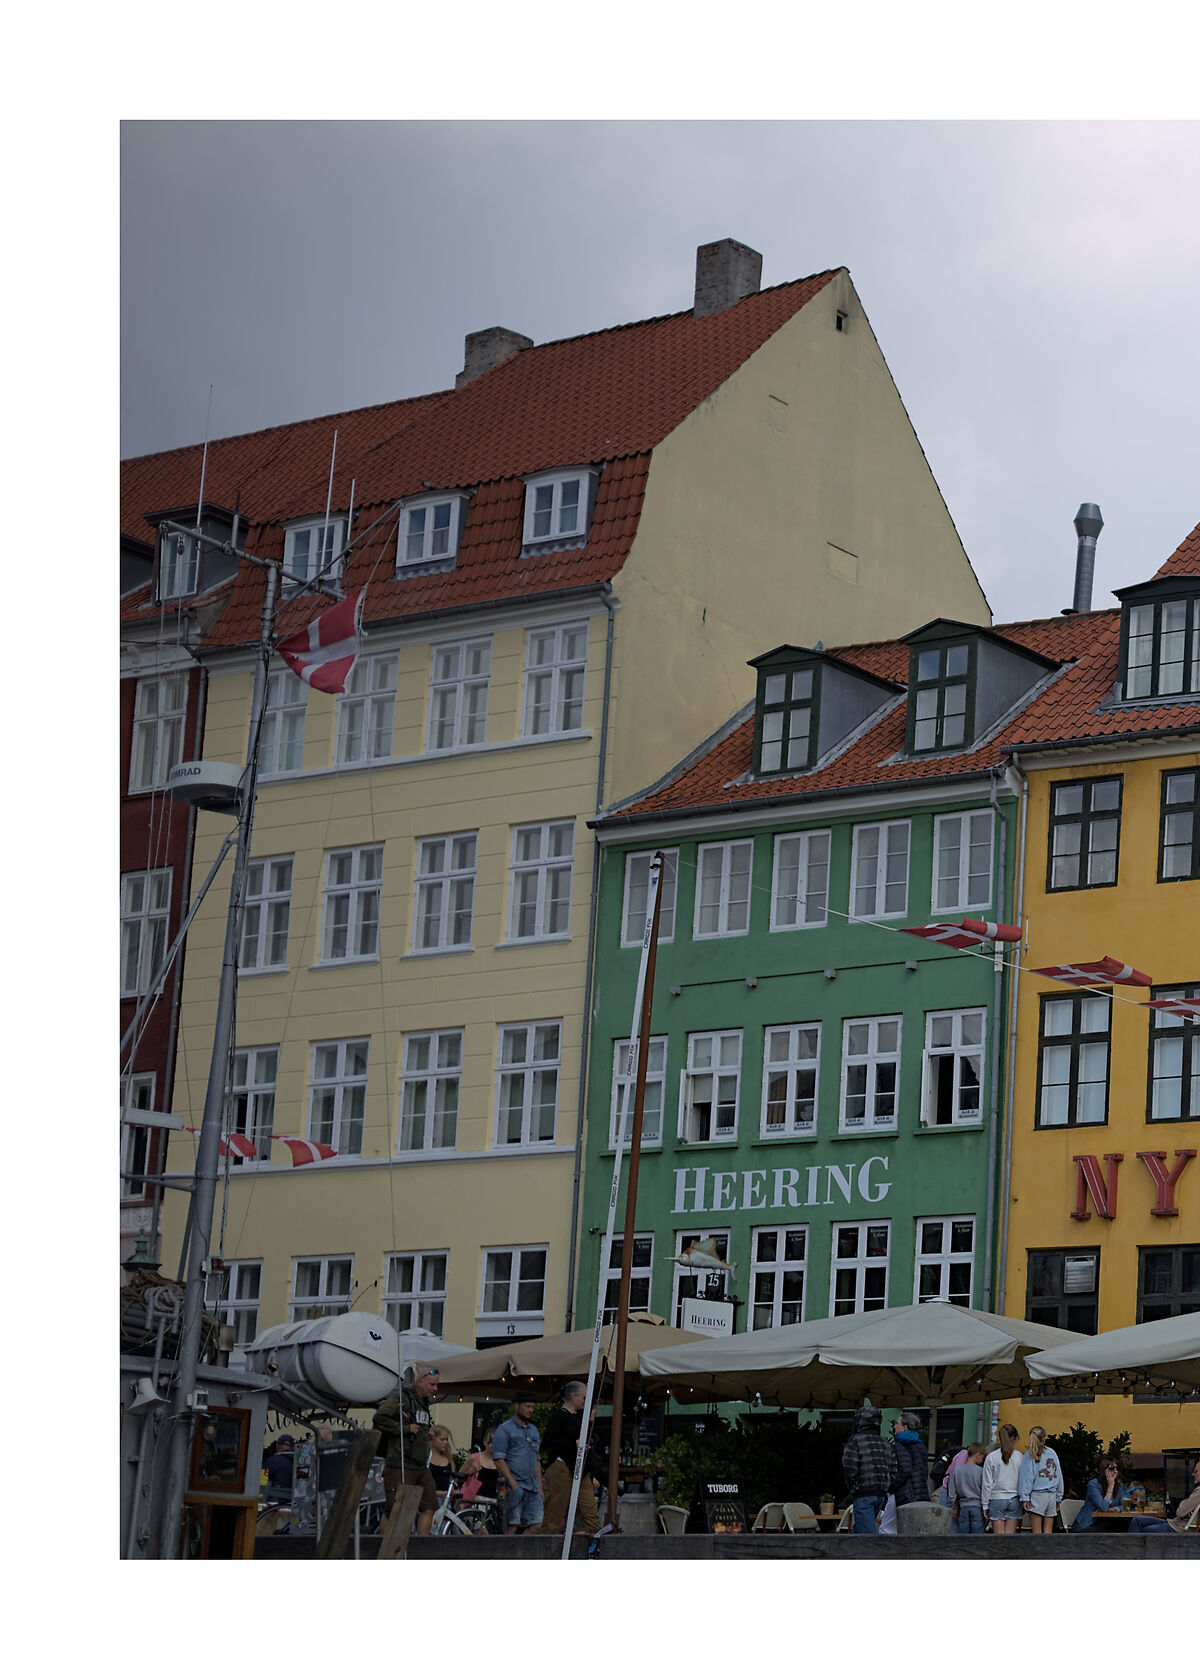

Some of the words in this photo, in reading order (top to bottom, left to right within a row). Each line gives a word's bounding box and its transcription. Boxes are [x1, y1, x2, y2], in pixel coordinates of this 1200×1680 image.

[171, 767, 201, 779] MRAD
[670, 1156, 892, 1213] HEERING
[707, 1274, 720, 1287] 15
[691, 1315, 726, 1327] HEERING
[507, 1324, 515, 1335] 13
[707, 1484, 739, 1493] TUBORG
